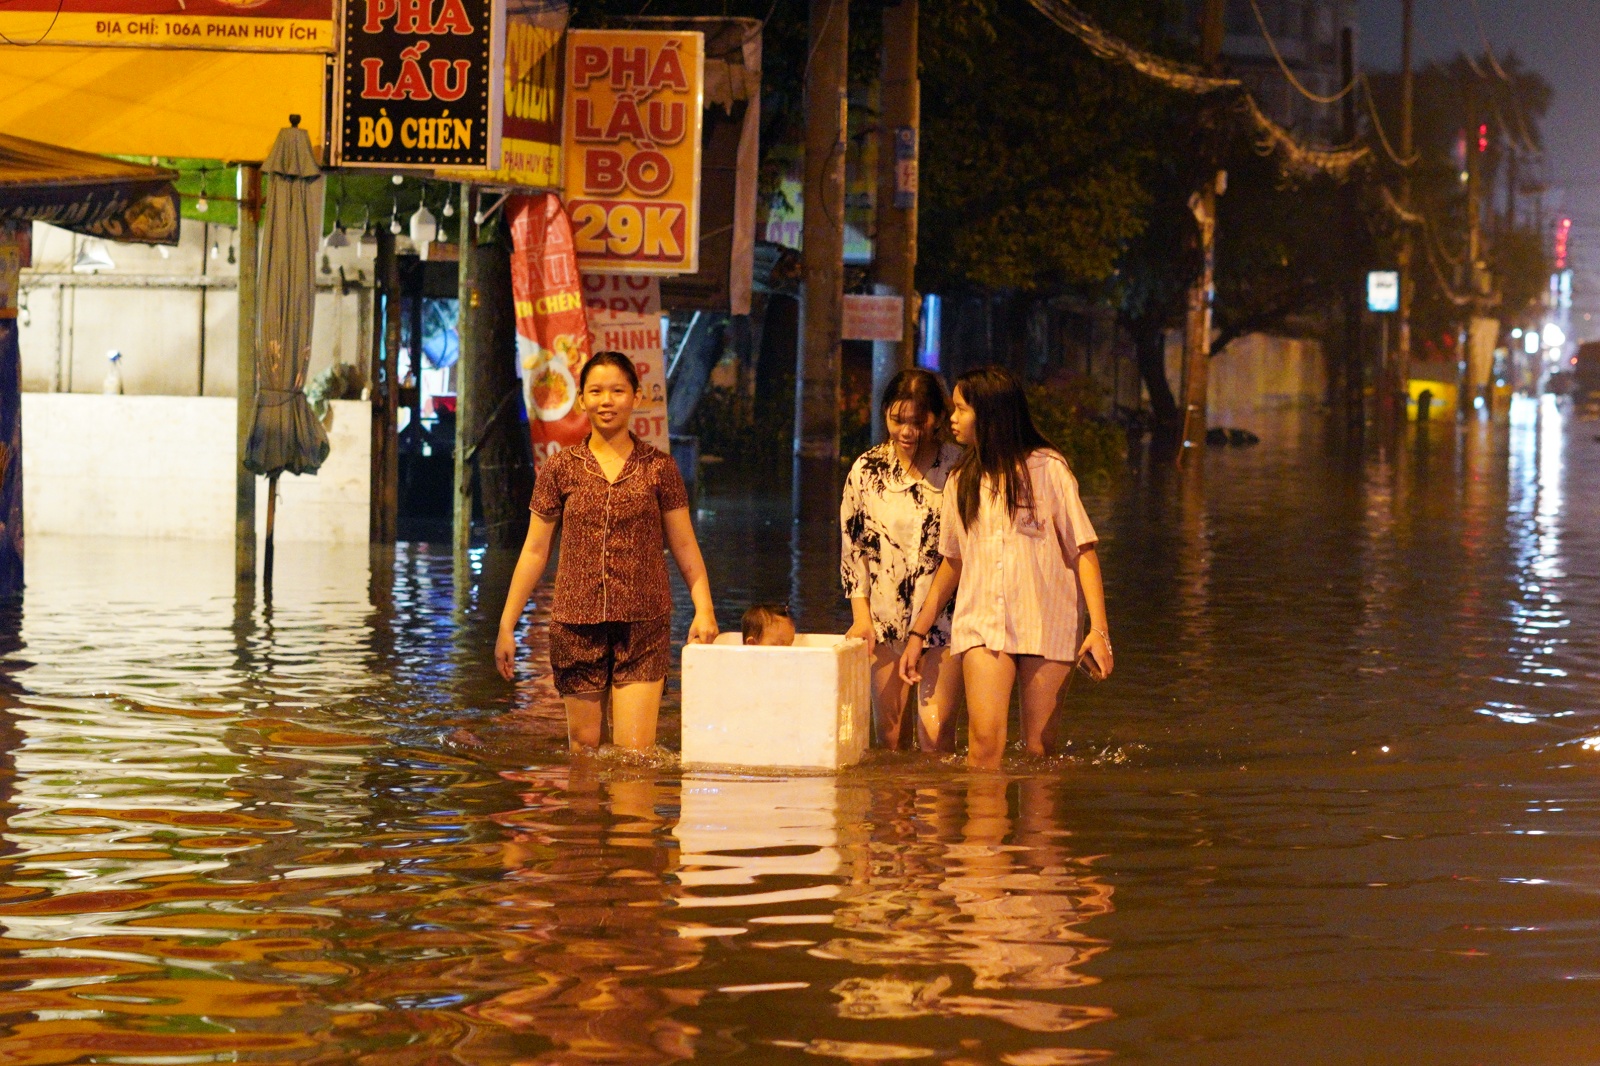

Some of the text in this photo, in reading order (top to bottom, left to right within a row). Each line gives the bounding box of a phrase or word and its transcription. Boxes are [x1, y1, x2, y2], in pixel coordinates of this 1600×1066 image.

[96, 21, 122, 38] ĐỊA
[165, 22, 202, 36] 106A
[207, 24, 249, 38] PHAN
[254, 25, 284, 39] HUY
[289, 22, 318, 40] ÍCH
[361, 40, 471, 101] LẤU
[573, 40, 689, 91] PHÁ
[358, 107, 473, 149] BÒ CHÉN
[574, 88, 686, 144] LẤU
[583, 139, 673, 196] BÒ
[572, 203, 682, 256] 29K
[536, 290, 582, 315] CHÉN
